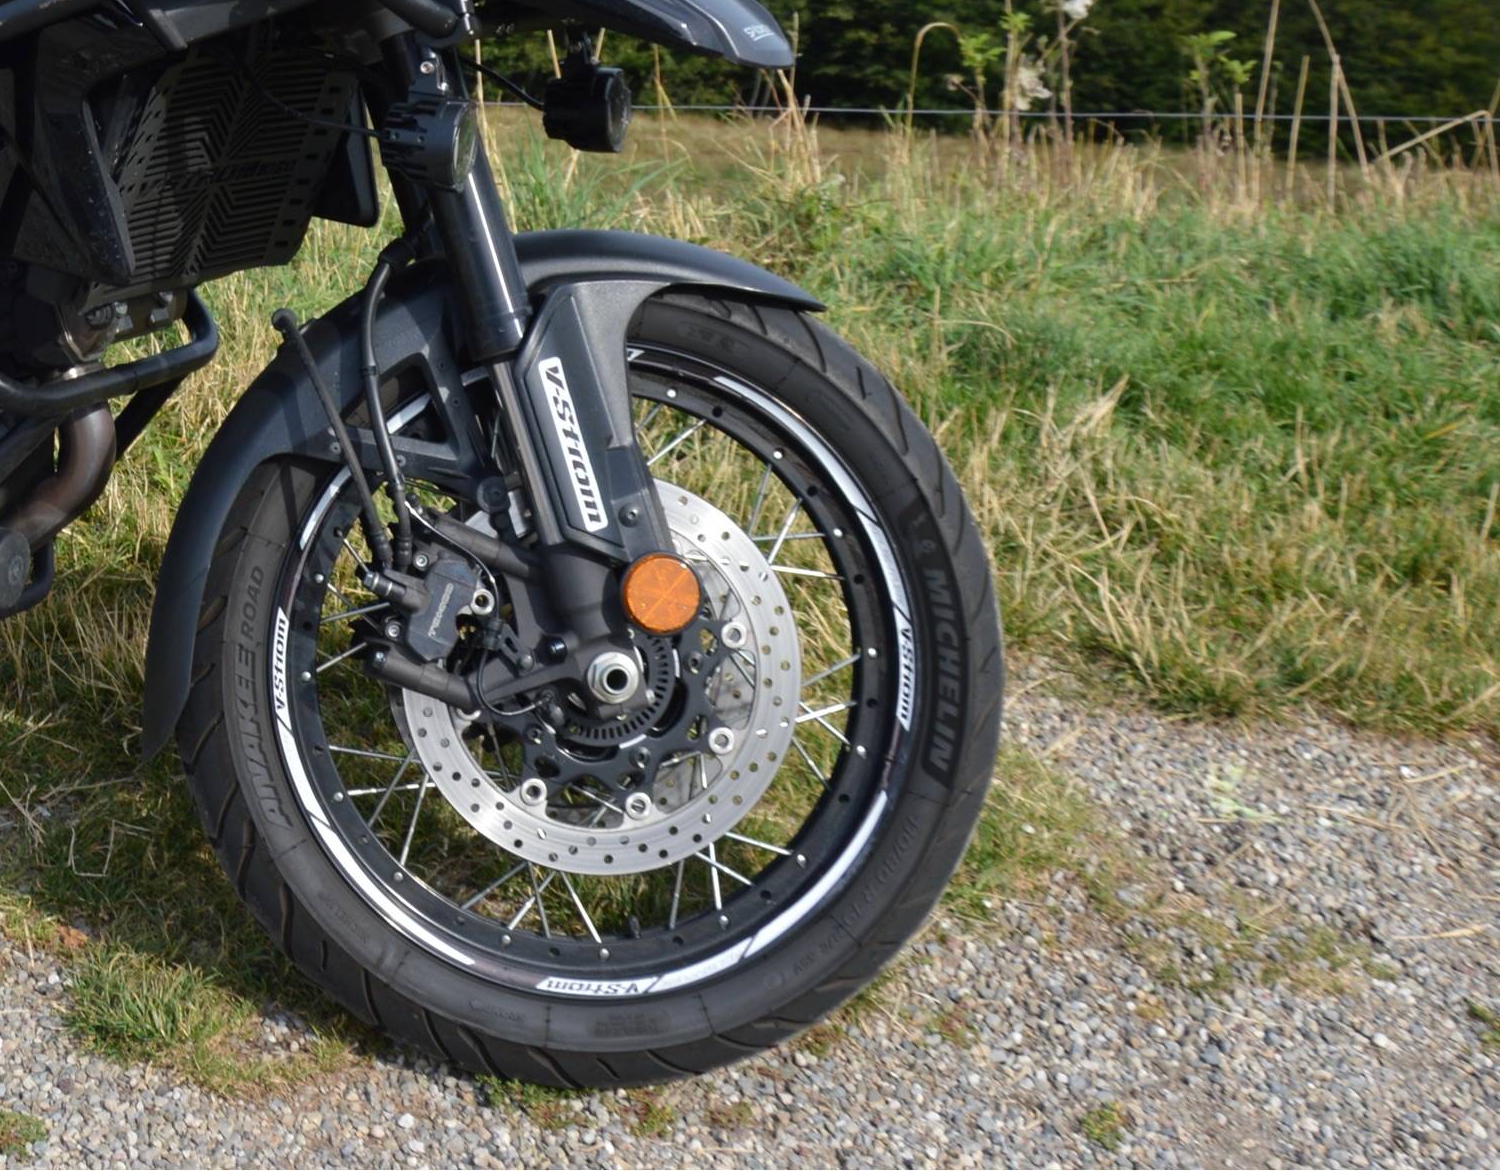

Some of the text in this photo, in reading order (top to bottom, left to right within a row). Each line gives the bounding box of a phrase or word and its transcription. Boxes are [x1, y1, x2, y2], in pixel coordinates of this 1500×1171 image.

[234, 565, 295, 829] ANAKEE ROAD
[924, 568, 963, 773] MICHELIN
